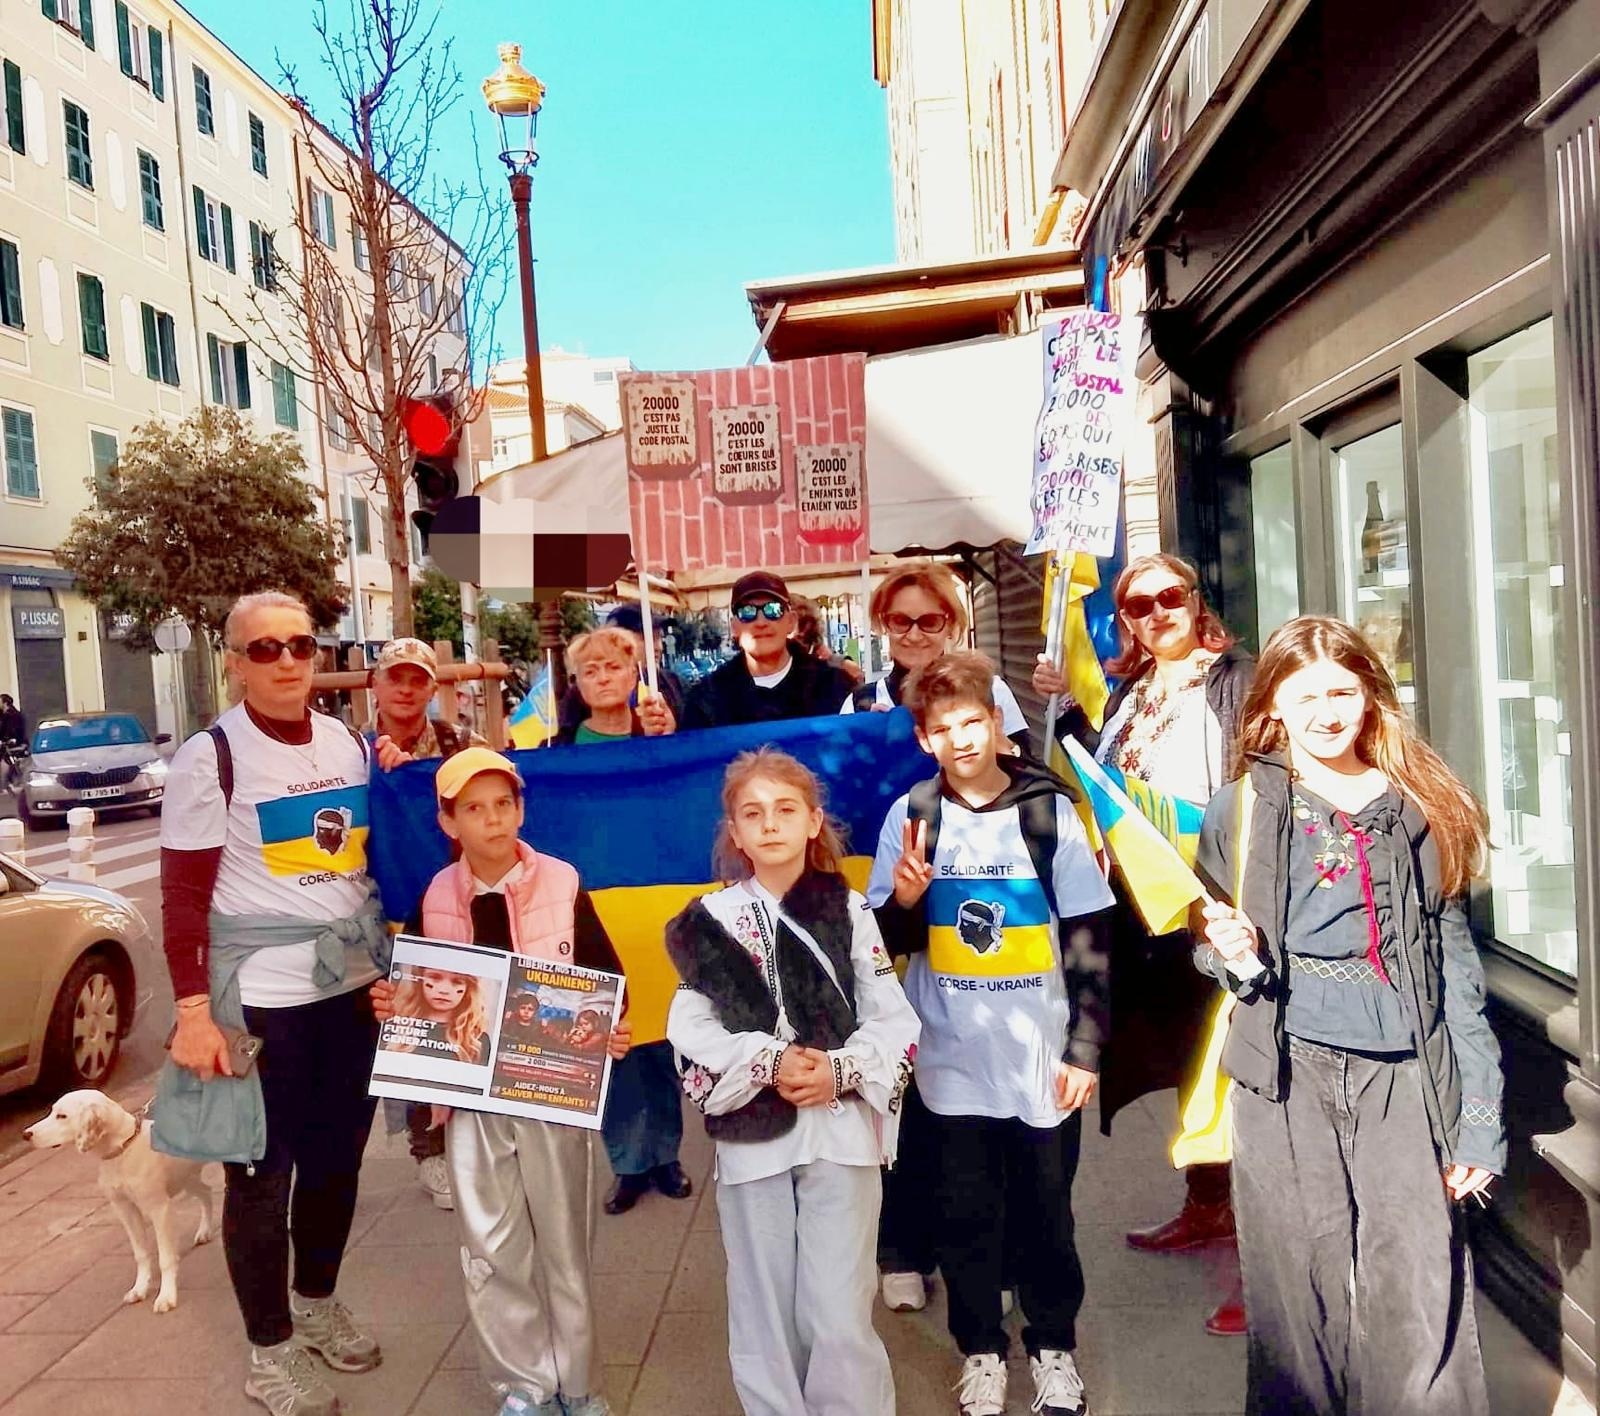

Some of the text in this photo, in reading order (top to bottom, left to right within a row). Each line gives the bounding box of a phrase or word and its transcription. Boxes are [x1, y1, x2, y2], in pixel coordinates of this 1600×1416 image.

[1096, 345, 1121, 362] LE
[642, 396, 680, 411] 20000
[1047, 388, 1106, 413] 20000
[643, 412, 681, 423] C'EST PAS
[645, 424, 680, 434] JUSTE LE
[727, 420, 765, 437] 20000
[1083, 424, 1112, 445] QUI
[639, 435, 690, 446] CODE POSTAL
[728, 437, 765, 450] C'EST LES
[762, 448, 775, 460] QUI
[720, 460, 777, 475] SONT BRISES
[811, 457, 847, 474] 20000
[812, 475, 847, 487] C'EST LES
[1040, 468, 1095, 491] 20000
[809, 486, 857, 499] ENFANTS QUI
[1068, 486, 1100, 508] LES
[801, 500, 832, 512] ETAIENT
[941, 862, 1014, 876] SOLIDARITÉ
[298, 871, 338, 887] CORSE
[938, 976, 977, 991] CORSE
[987, 976, 1043, 992] UKRAINE
[383, 1023, 430, 1038] FUTURE
[382, 1033, 460, 1053] GENERATIONS
[500, 1087, 533, 1100] SAUVER
[533, 1091, 547, 1101] NOS
[513, 1081, 559, 1095] AIDEZ-NOUS
